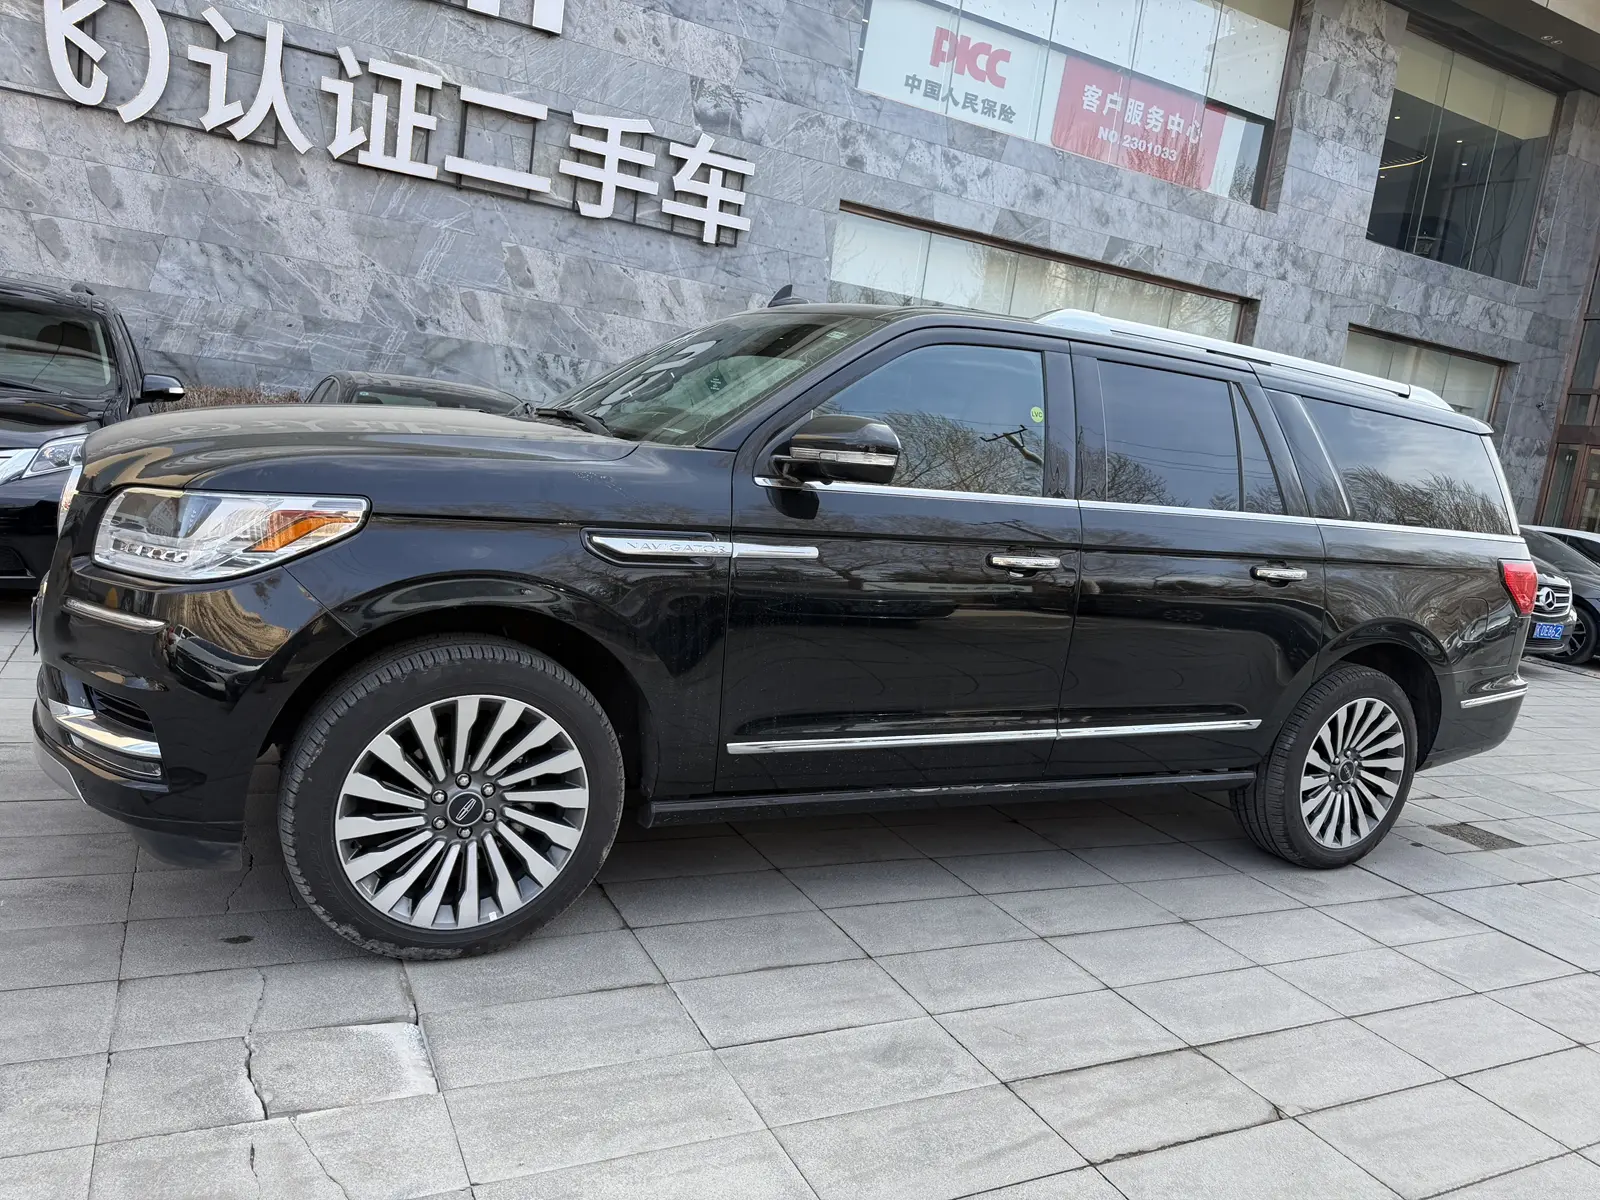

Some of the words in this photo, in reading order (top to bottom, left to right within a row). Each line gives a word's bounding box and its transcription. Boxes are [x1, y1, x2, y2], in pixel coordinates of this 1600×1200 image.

[930, 26, 1012, 89] PICC
[188, 8, 756, 244] 认证二手车
[904, 74, 1016, 124] 中国人民保险
[1082, 84, 1203, 144] 客户服务中心
